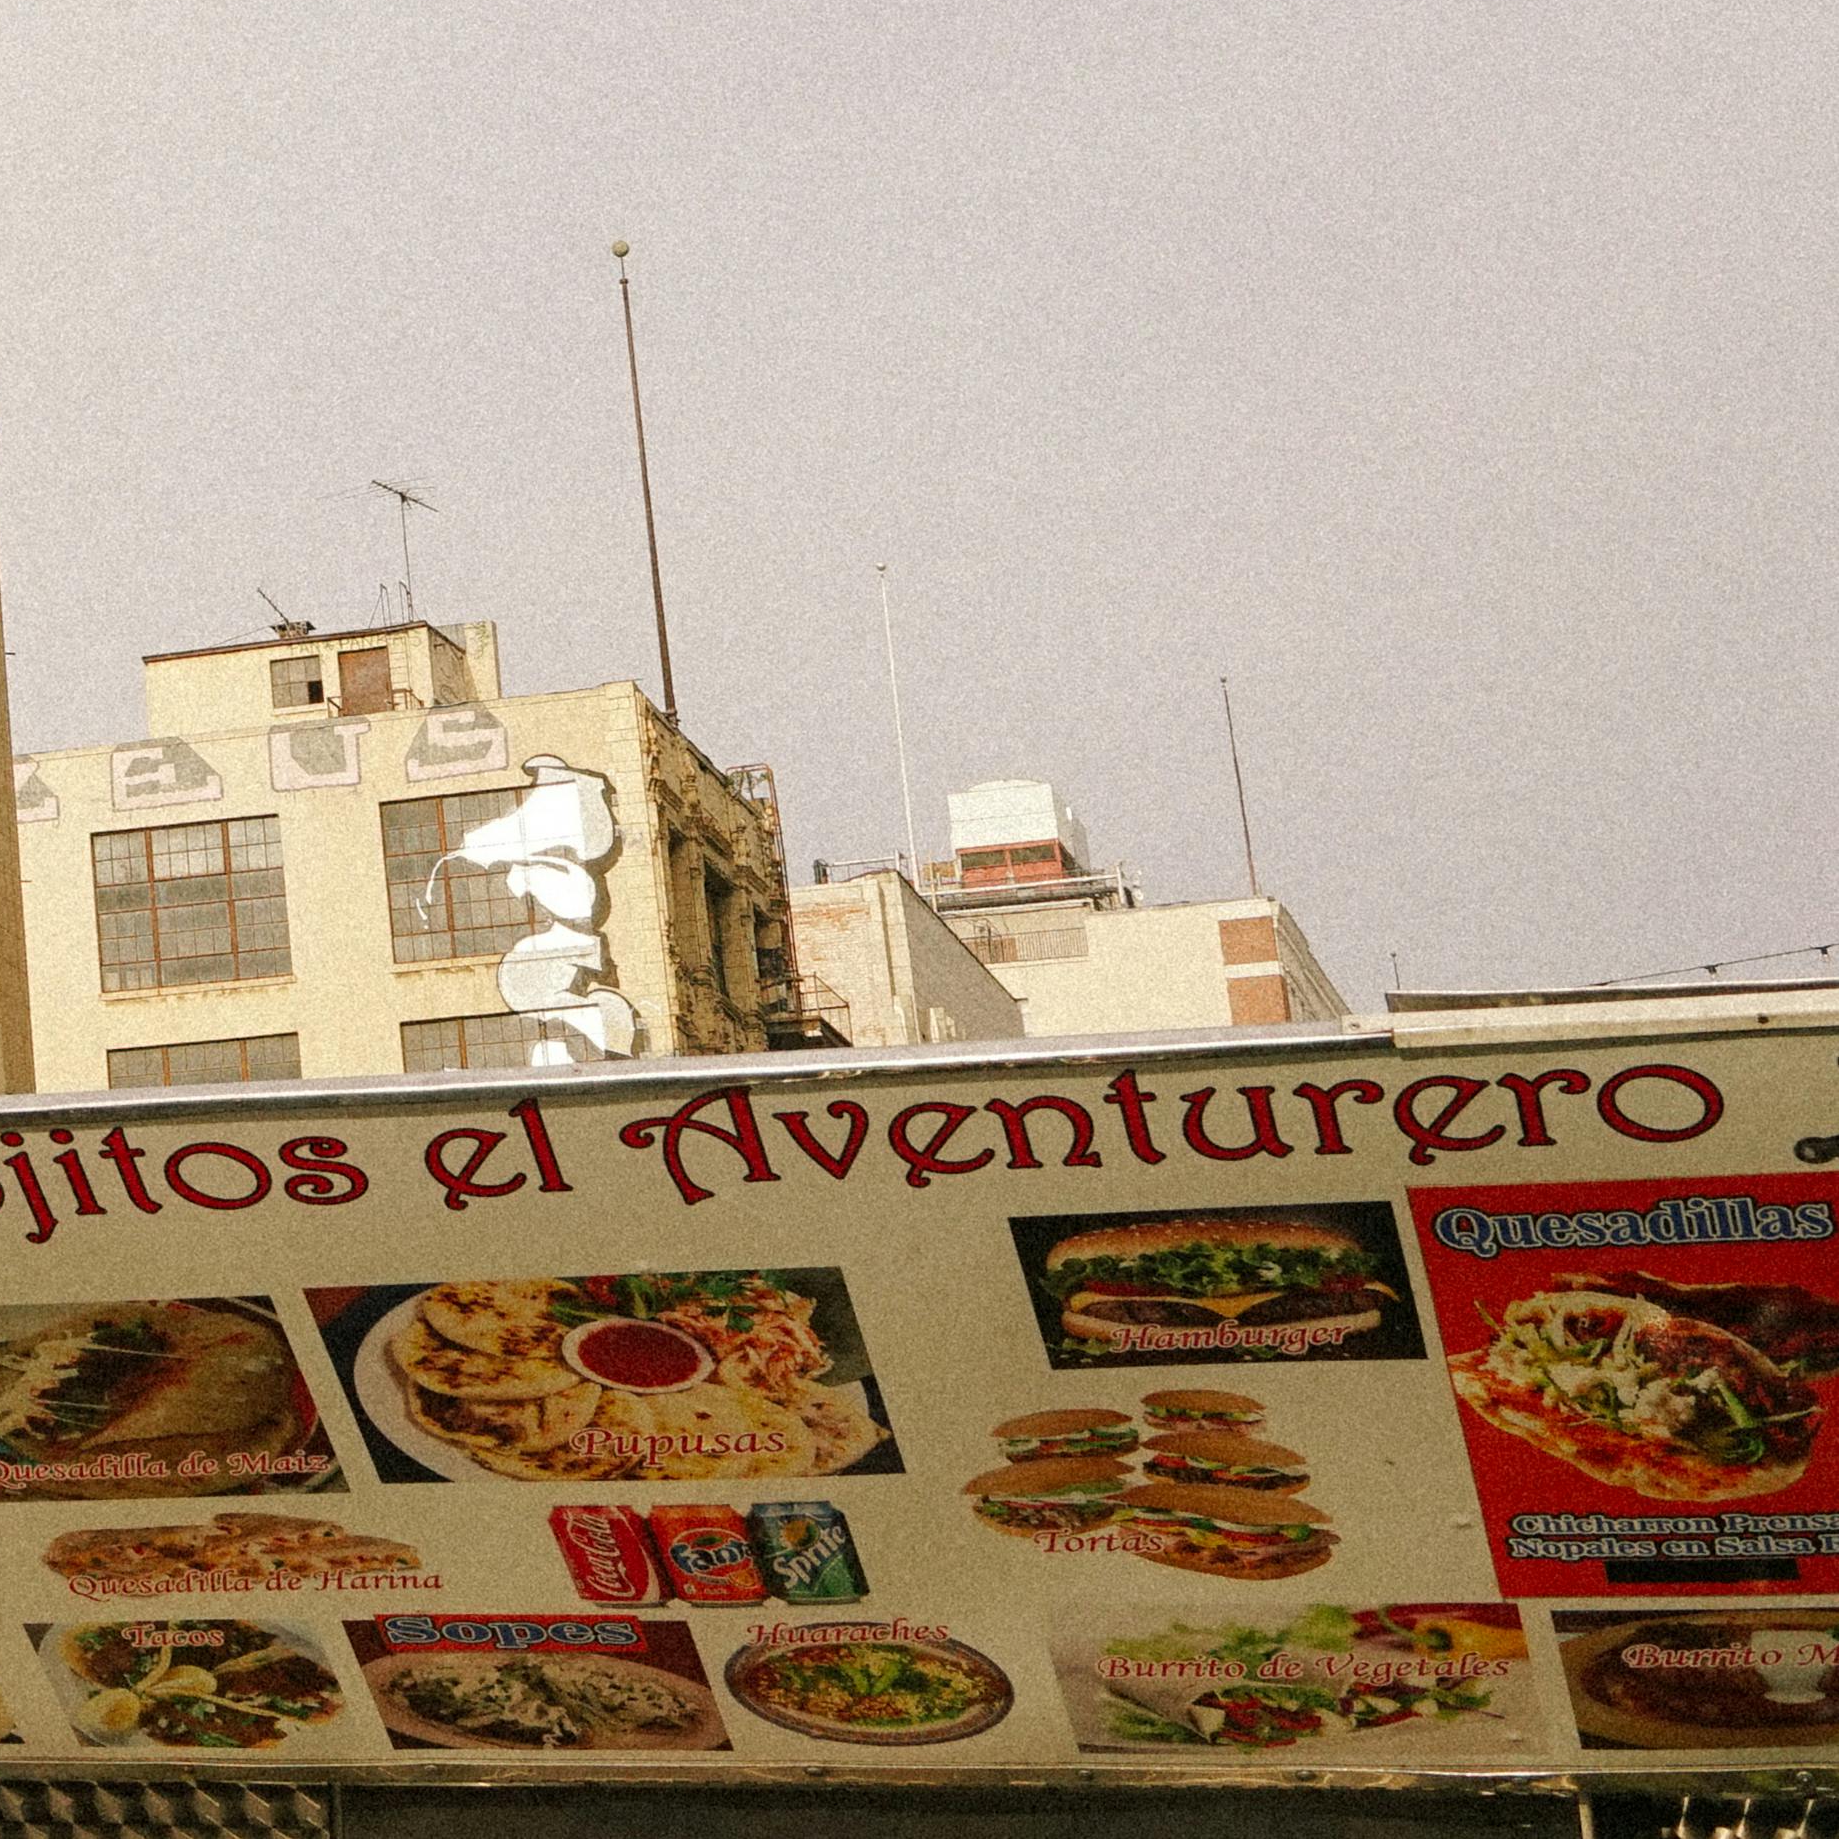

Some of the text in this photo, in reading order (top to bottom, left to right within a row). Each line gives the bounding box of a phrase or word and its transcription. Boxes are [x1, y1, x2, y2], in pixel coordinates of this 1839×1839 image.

[423, 1100, 575, 1211] el
[619, 1064, 1725, 1206] Aventurero
[1435, 1196, 1835, 1258] Quesadillas
[1109, 1319, 1351, 1355] Hamburger
[179, 1450, 219, 1477] de
[227, 1449, 331, 1476] Maiz
[570, 1427, 787, 1469] Pupusas
[1034, 1528, 1167, 1554] Tortas
[1511, 1514, 1724, 1535] Chicharron
[773, 1525, 846, 1589] Sprite
[1510, 1535, 1655, 1560] Nopales
[1661, 1537, 1707, 1557] en
[1714, 1534, 1815, 1557] Salsa
[68, 1567, 443, 1603] Quesadilla de Harina
[121, 1623, 225, 1648] Tacos
[382, 1615, 640, 1650] Sopes
[746, 1618, 950, 1646] Huaraches
[1097, 1651, 1510, 1687] Burrito de Vegetales
[1621, 1641, 1783, 1668] Burrito
